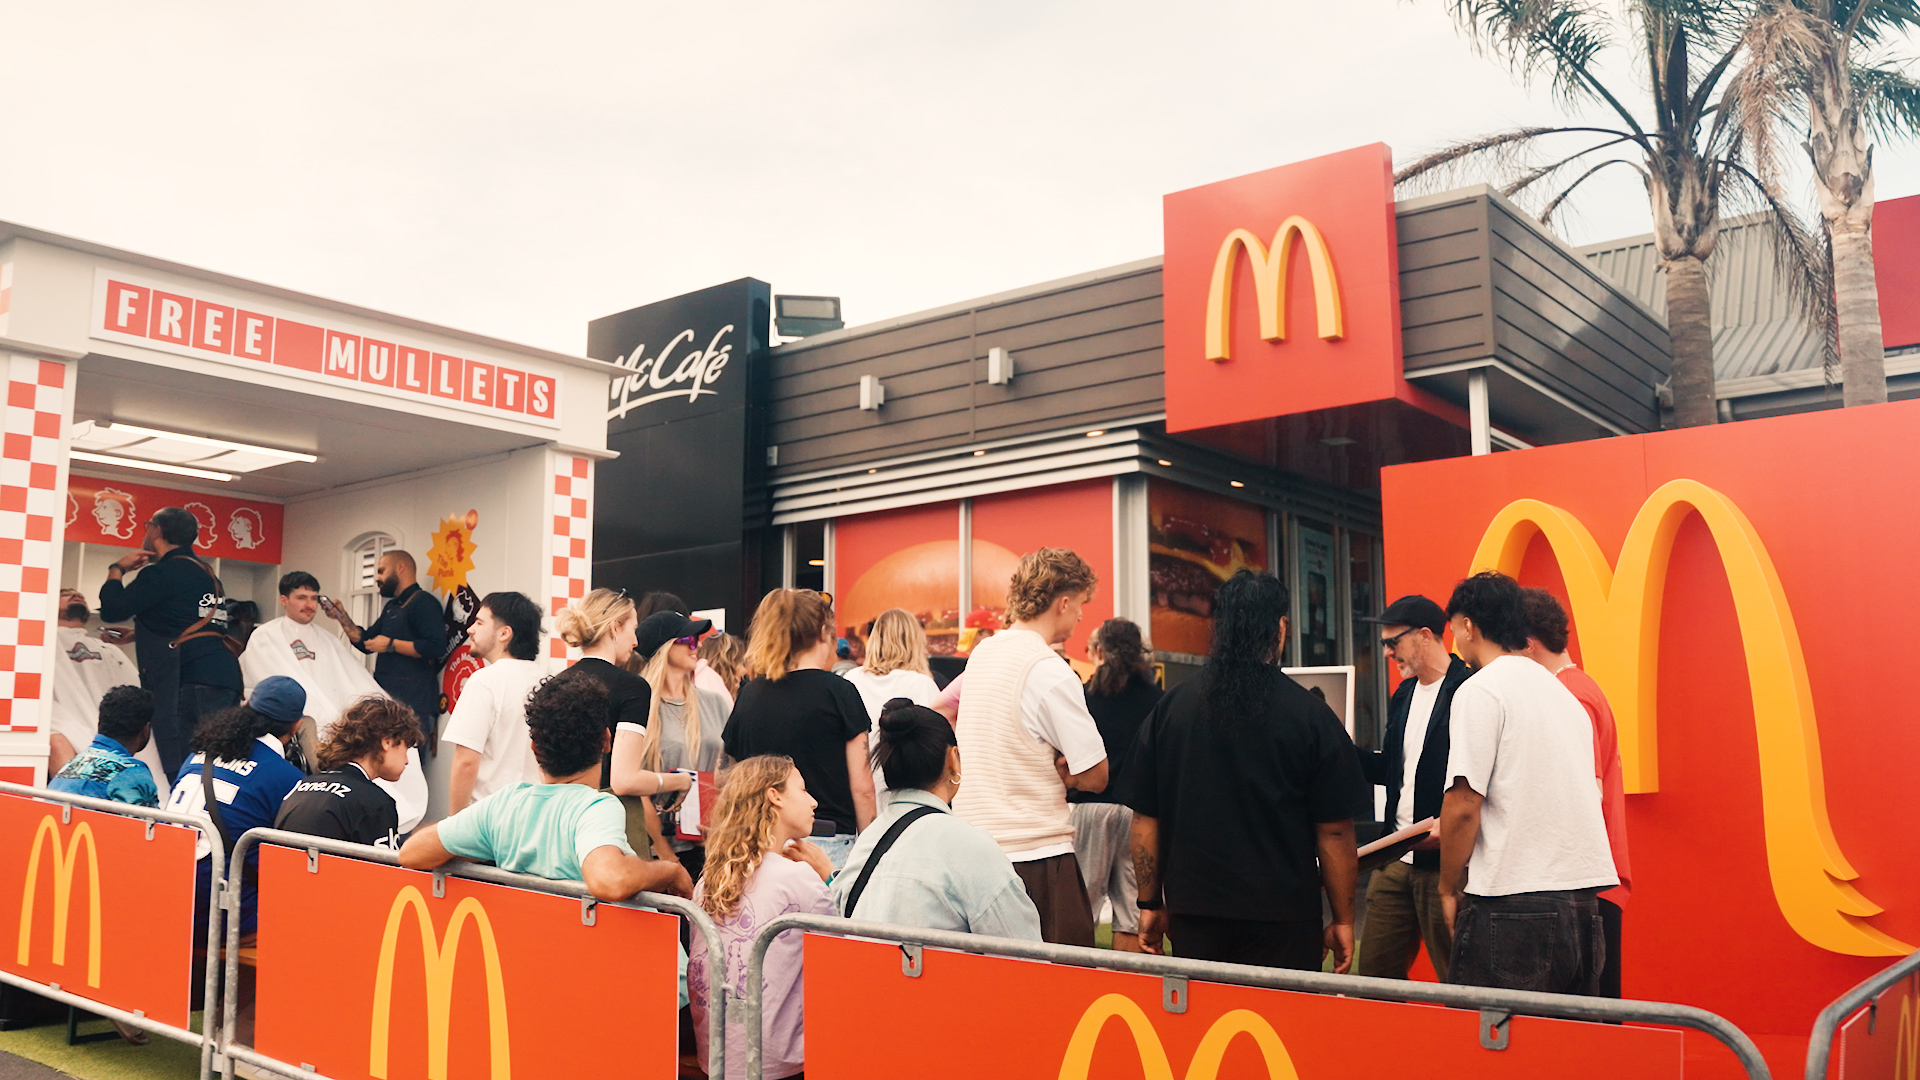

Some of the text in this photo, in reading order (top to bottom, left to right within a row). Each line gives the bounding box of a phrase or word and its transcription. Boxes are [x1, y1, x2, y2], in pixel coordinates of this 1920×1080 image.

[117, 288, 549, 413] FREE MULLETS
[610, 324, 734, 419] McCafé
[449, 657, 461, 672] The
[298, 781, 352, 798] one.nz
